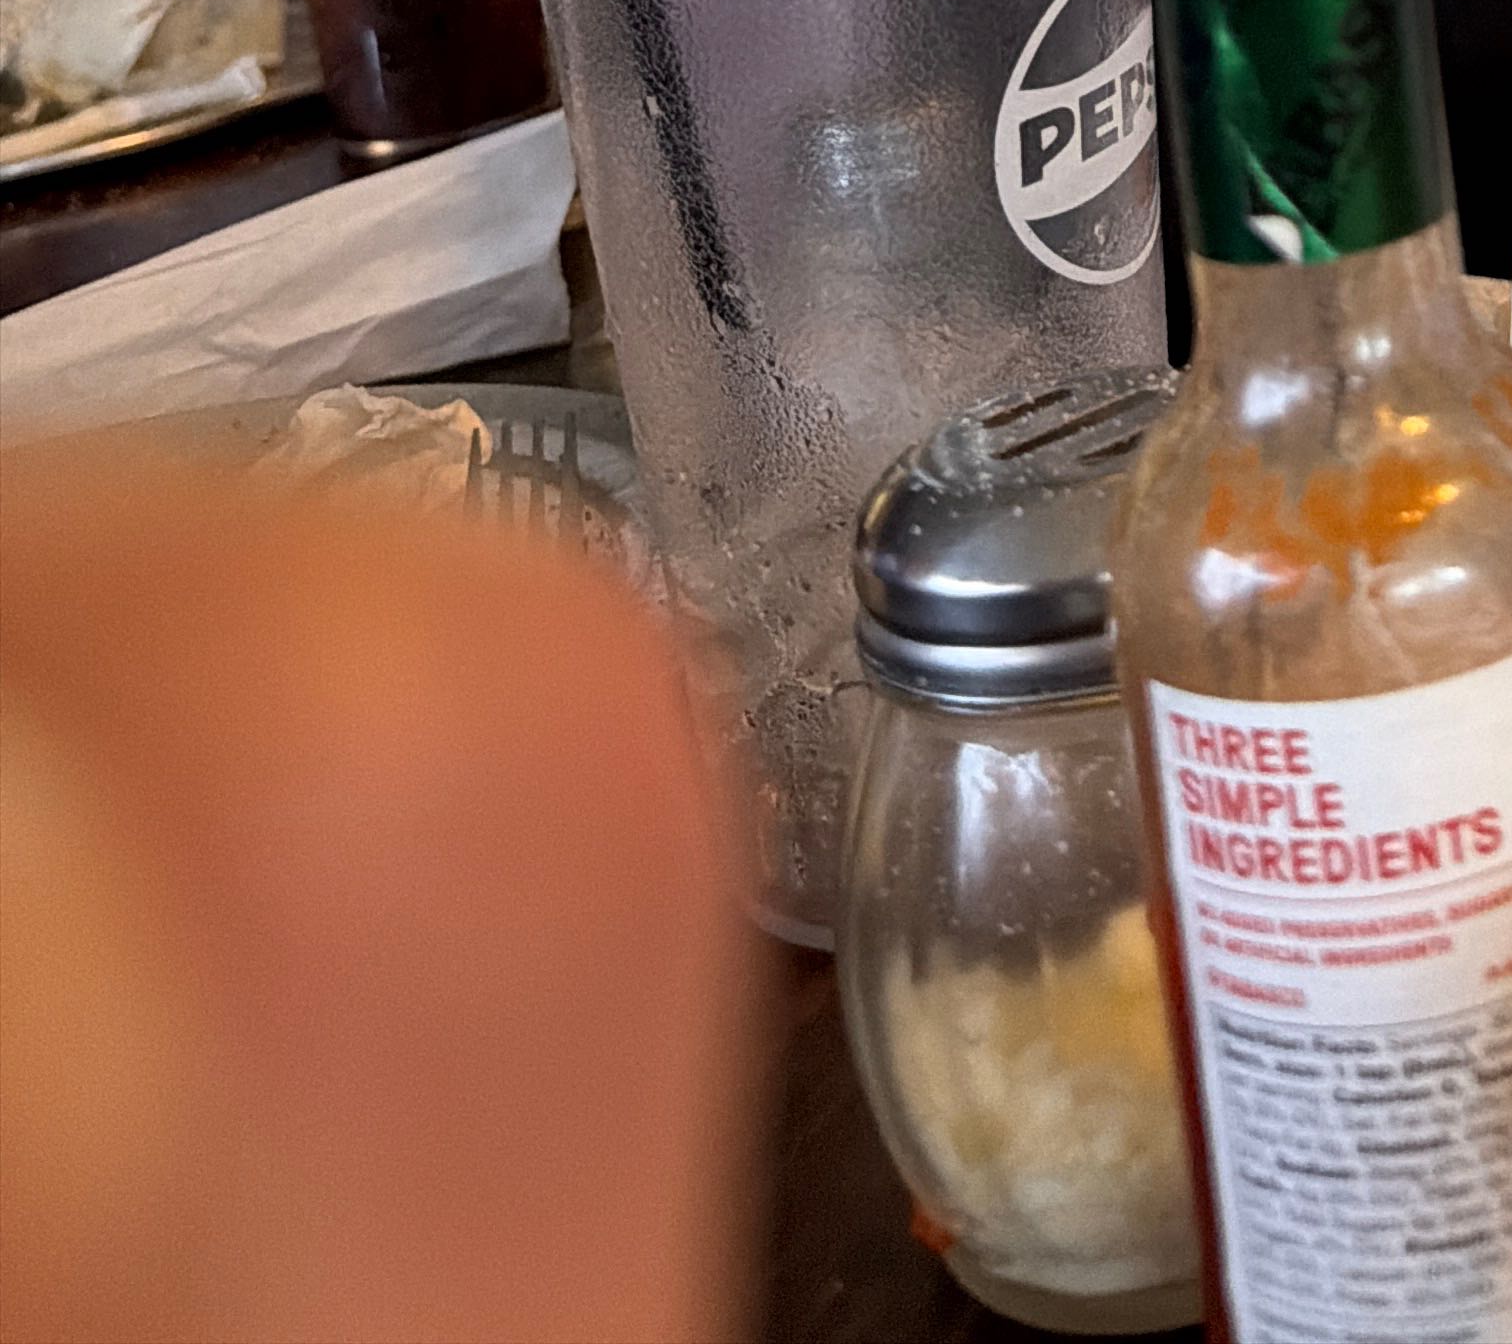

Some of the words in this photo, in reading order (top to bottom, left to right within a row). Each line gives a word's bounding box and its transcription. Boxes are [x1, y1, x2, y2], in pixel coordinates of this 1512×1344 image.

[1169, 714, 1313, 776] THREE
[1178, 768, 1345, 829] SIMPLE
[1188, 806, 1502, 885] INGREDIENTS
